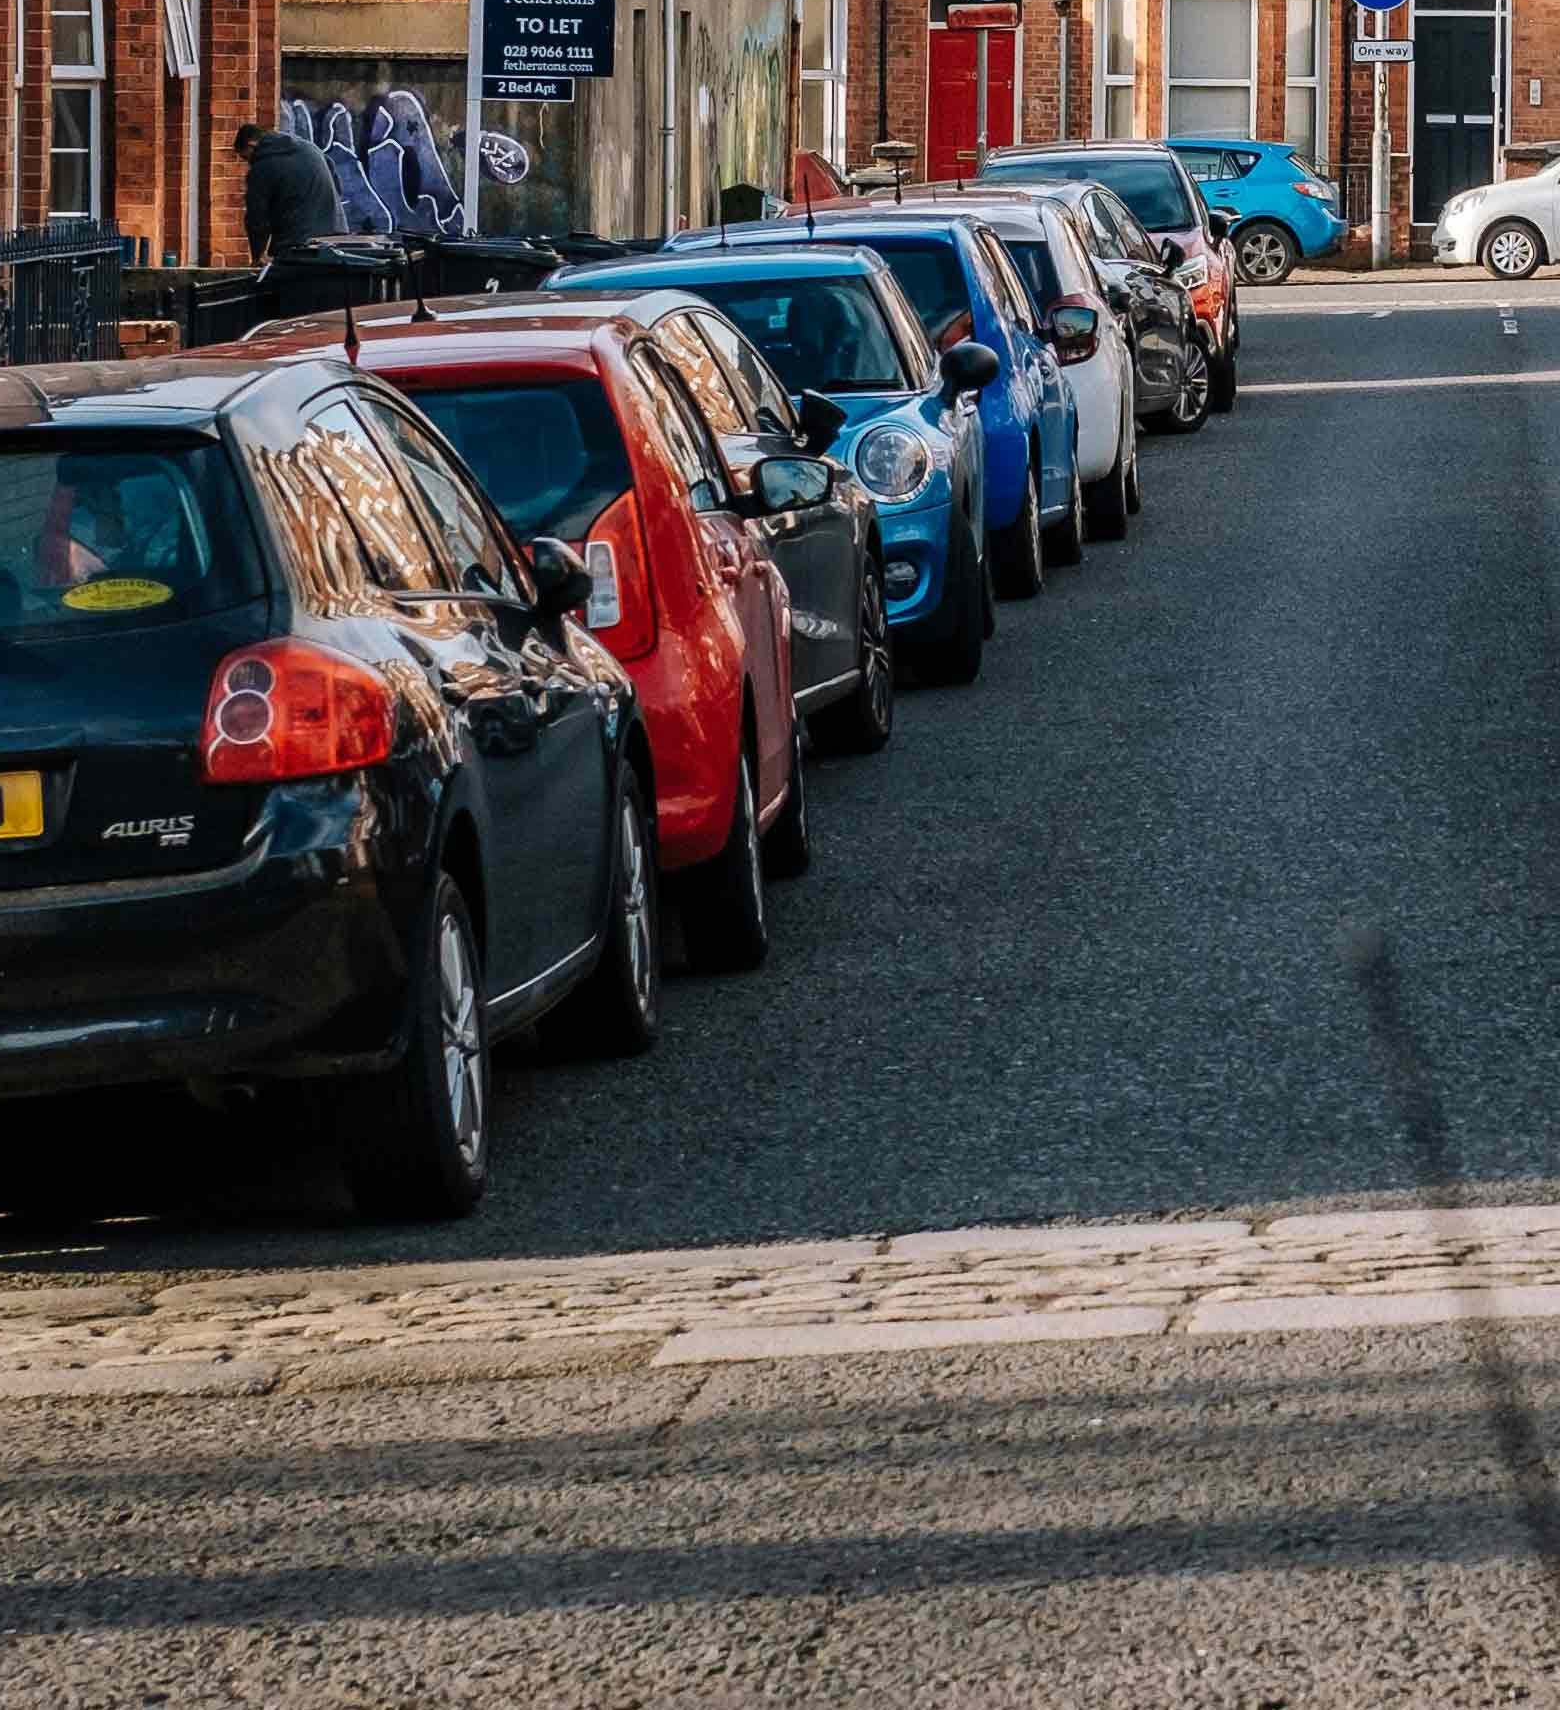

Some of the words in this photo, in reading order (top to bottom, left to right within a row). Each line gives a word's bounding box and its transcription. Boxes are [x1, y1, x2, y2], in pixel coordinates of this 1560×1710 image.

[516, 17, 544, 34] TO
[549, 18, 583, 34] LET
[503, 45, 528, 57] 028
[531, 46, 563, 58] 9066
[567, 47, 594, 59] 1111
[1358, 46, 1382, 56] One
[1385, 47, 1409, 57] way
[503, 59, 593, 72] fetherstons.com
[498, 81, 506, 93] 2
[508, 81, 532, 93] Bed
[534, 82, 557, 96] Apt
[102, 814, 195, 839] AURIS
